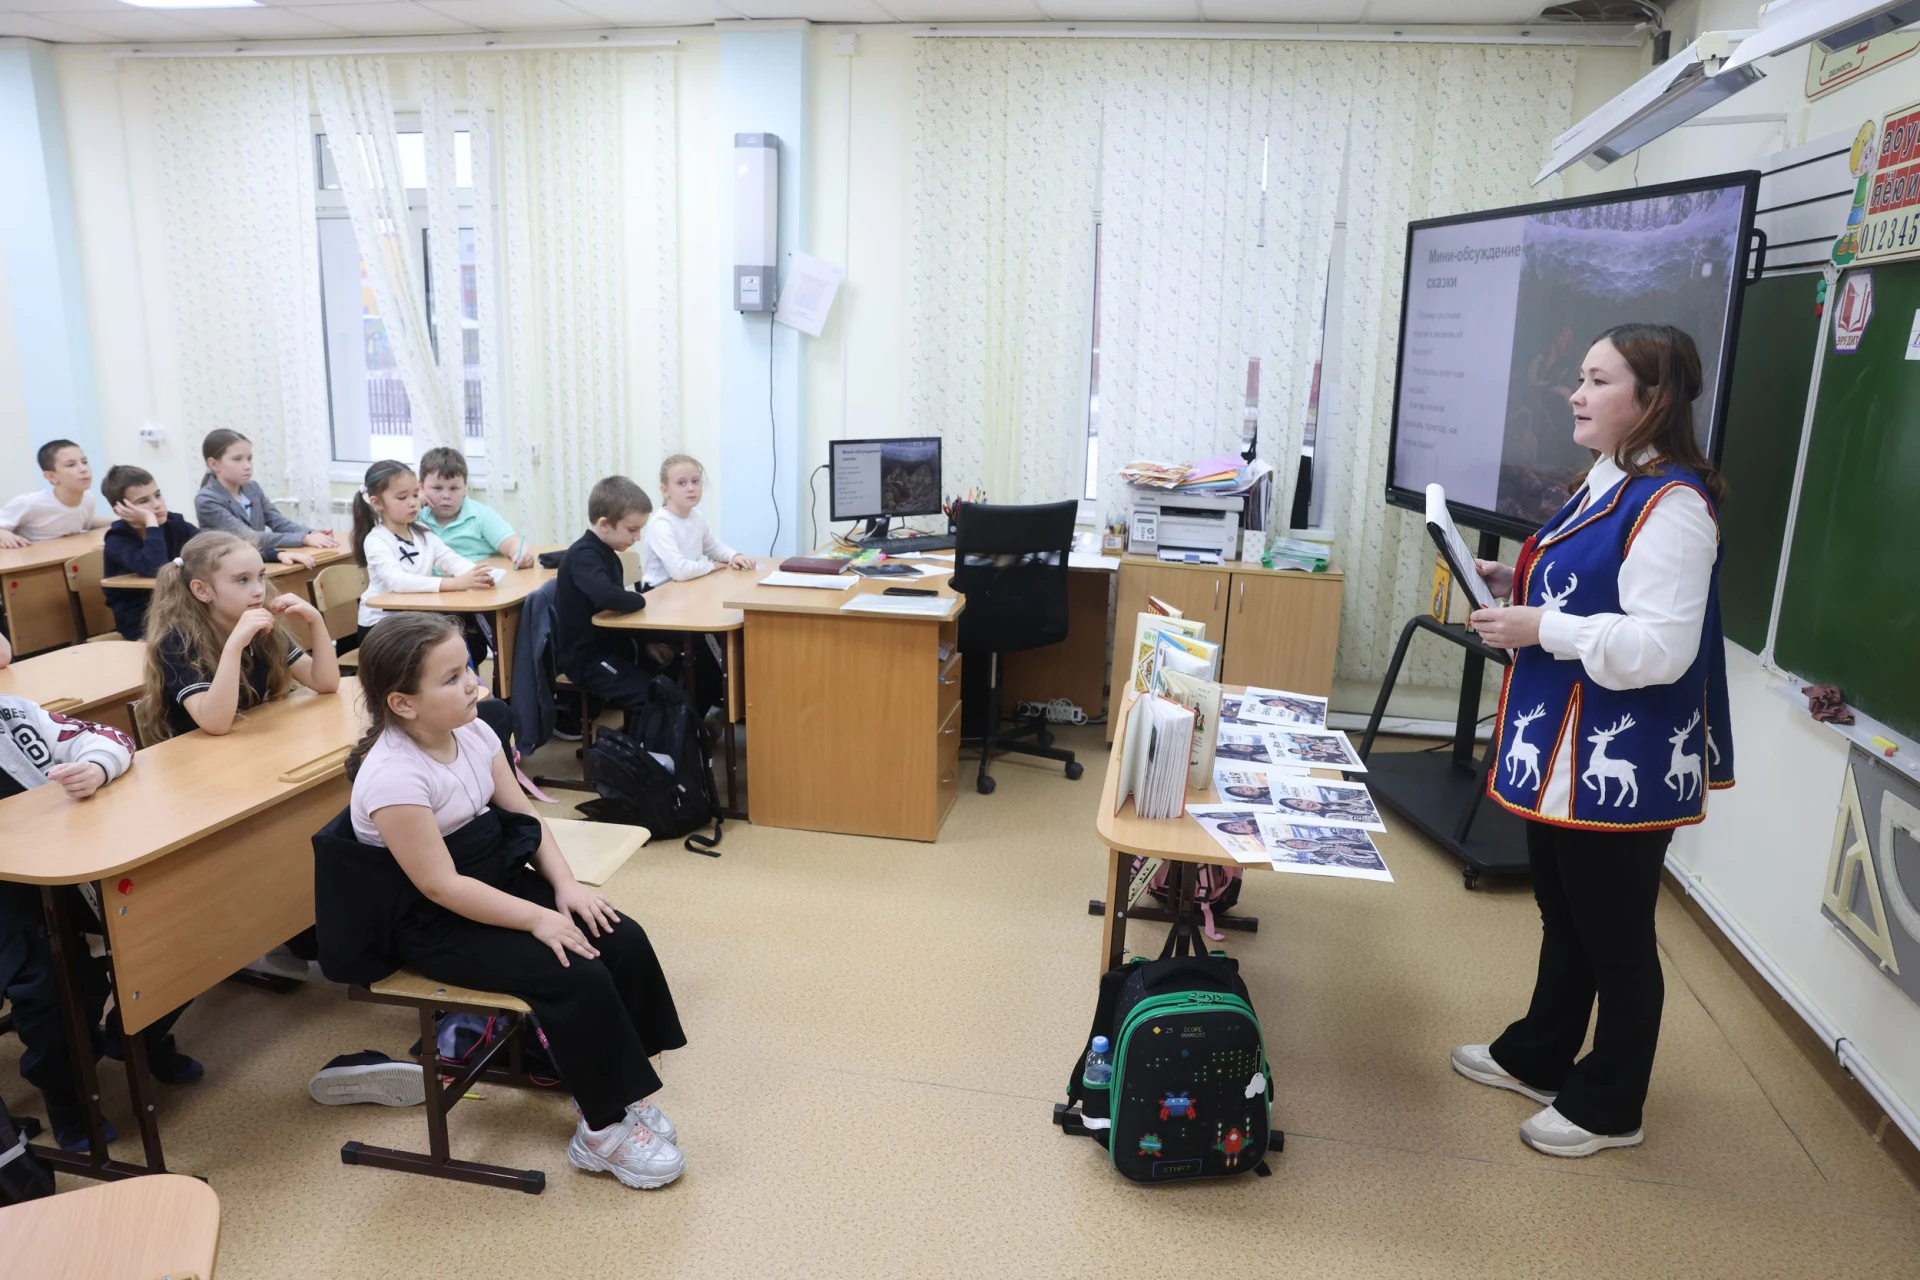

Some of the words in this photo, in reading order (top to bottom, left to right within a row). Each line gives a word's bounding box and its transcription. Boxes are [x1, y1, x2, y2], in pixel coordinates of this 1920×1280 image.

[1428, 245, 1521, 264] Мини-обсуждение
[1426, 276, 1457, 289] сказки
[1163, 1165, 1191, 1173] START
